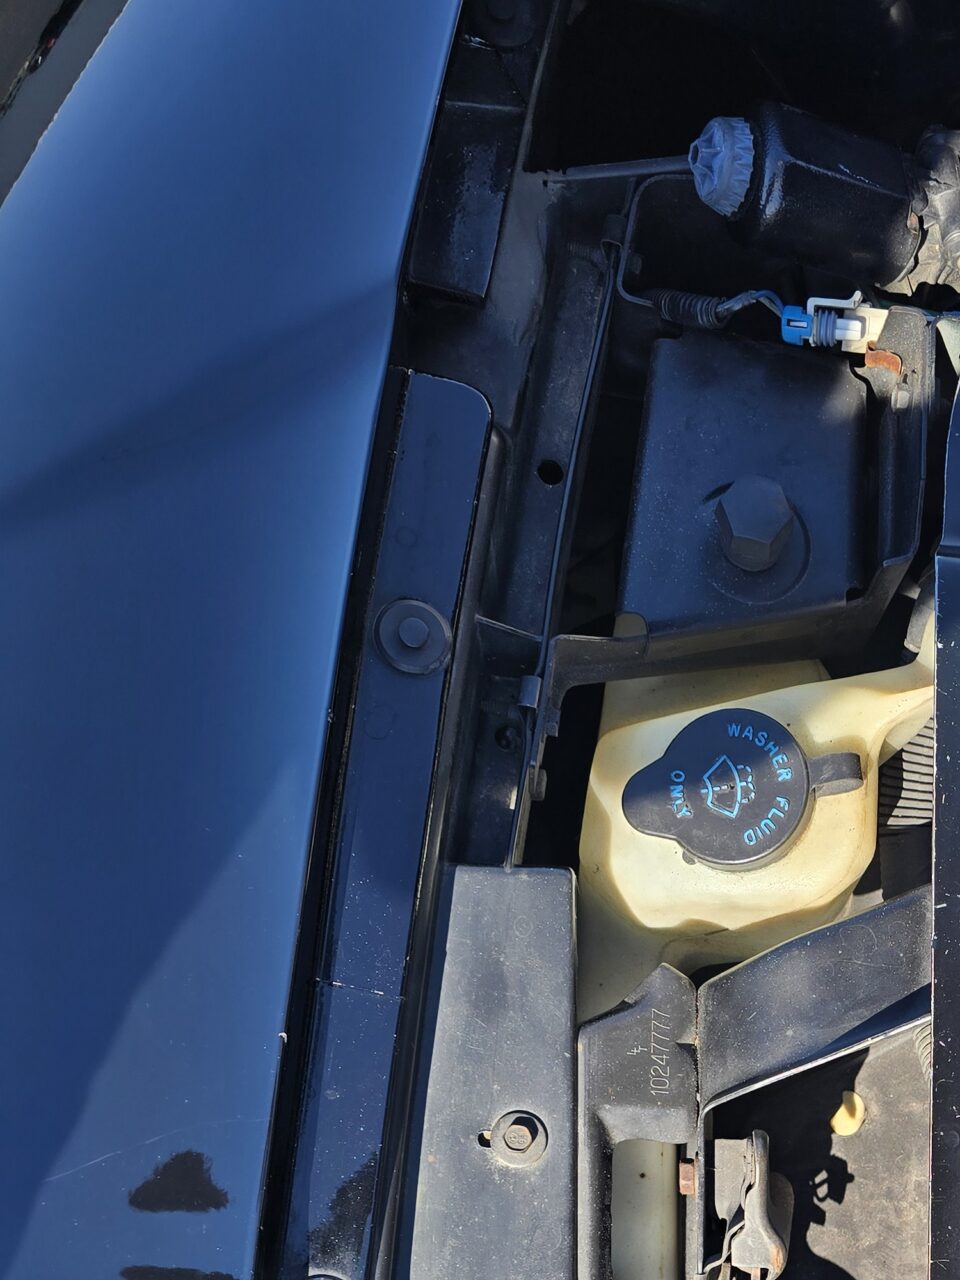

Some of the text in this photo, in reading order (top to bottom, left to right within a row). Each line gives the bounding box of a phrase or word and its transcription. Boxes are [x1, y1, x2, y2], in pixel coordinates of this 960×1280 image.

[670, 770, 692, 818] ONLY
[726, 723, 792, 846] WASHER FLUID
[649, 1008, 671, 1096] 10247777
